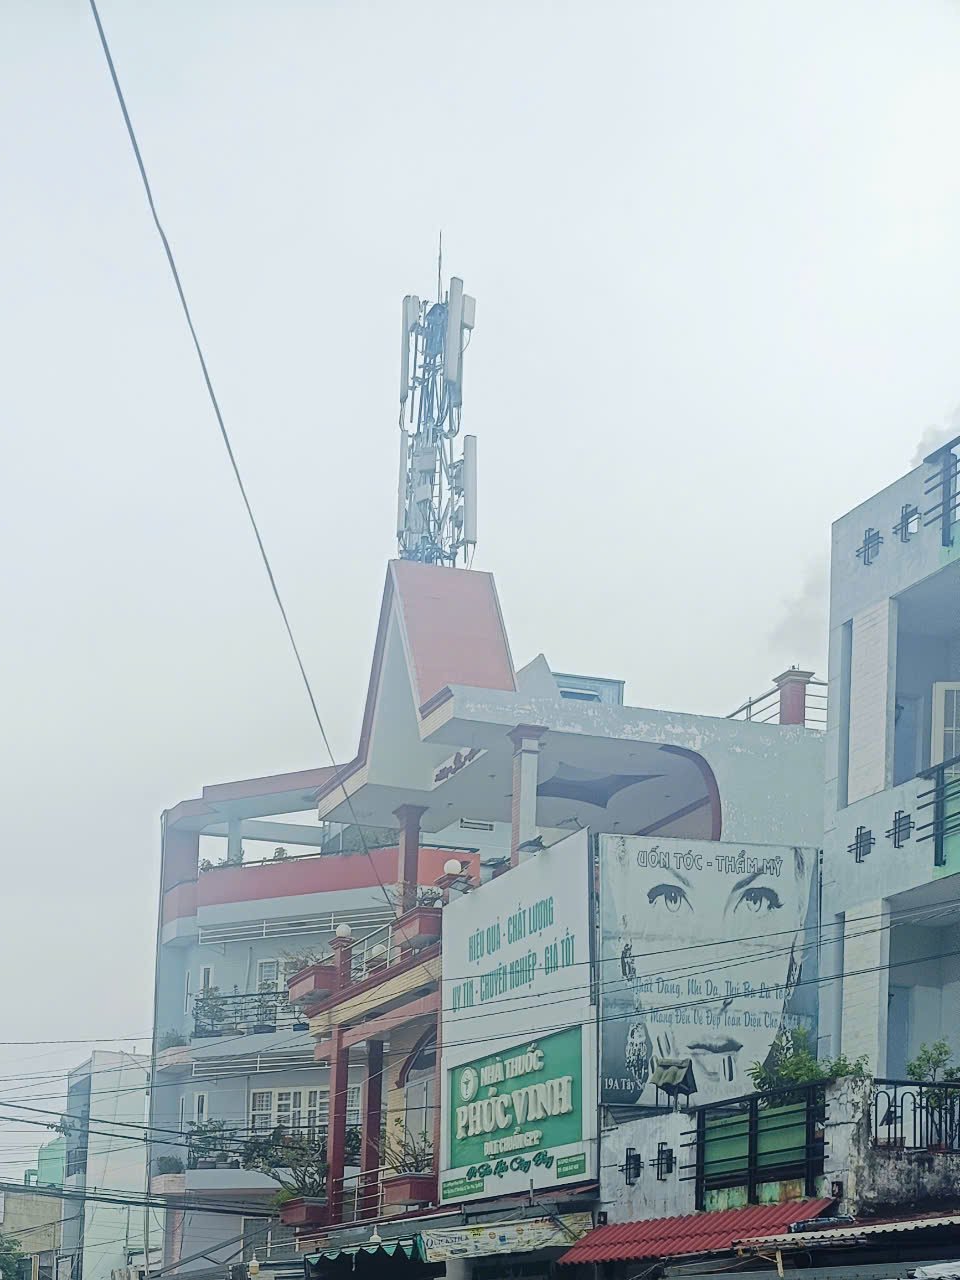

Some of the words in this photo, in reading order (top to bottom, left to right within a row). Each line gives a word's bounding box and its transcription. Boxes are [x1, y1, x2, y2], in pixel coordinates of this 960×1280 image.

[674, 849, 703, 871] TÓC
[715, 850, 758, 874] THẨM
[468, 928, 485, 965] HIỆU
[507, 903, 527, 945] CHẤT
[528, 896, 554, 937] LƯỢNG
[544, 937, 559, 976] GIÁ
[480, 1056, 504, 1087] NHÀ
[504, 1043, 545, 1079] THUỐC
[604, 1078, 620, 1090] 19A
[456, 1087, 513, 1140] PHÚC
[512, 1076, 573, 1125] VINH
